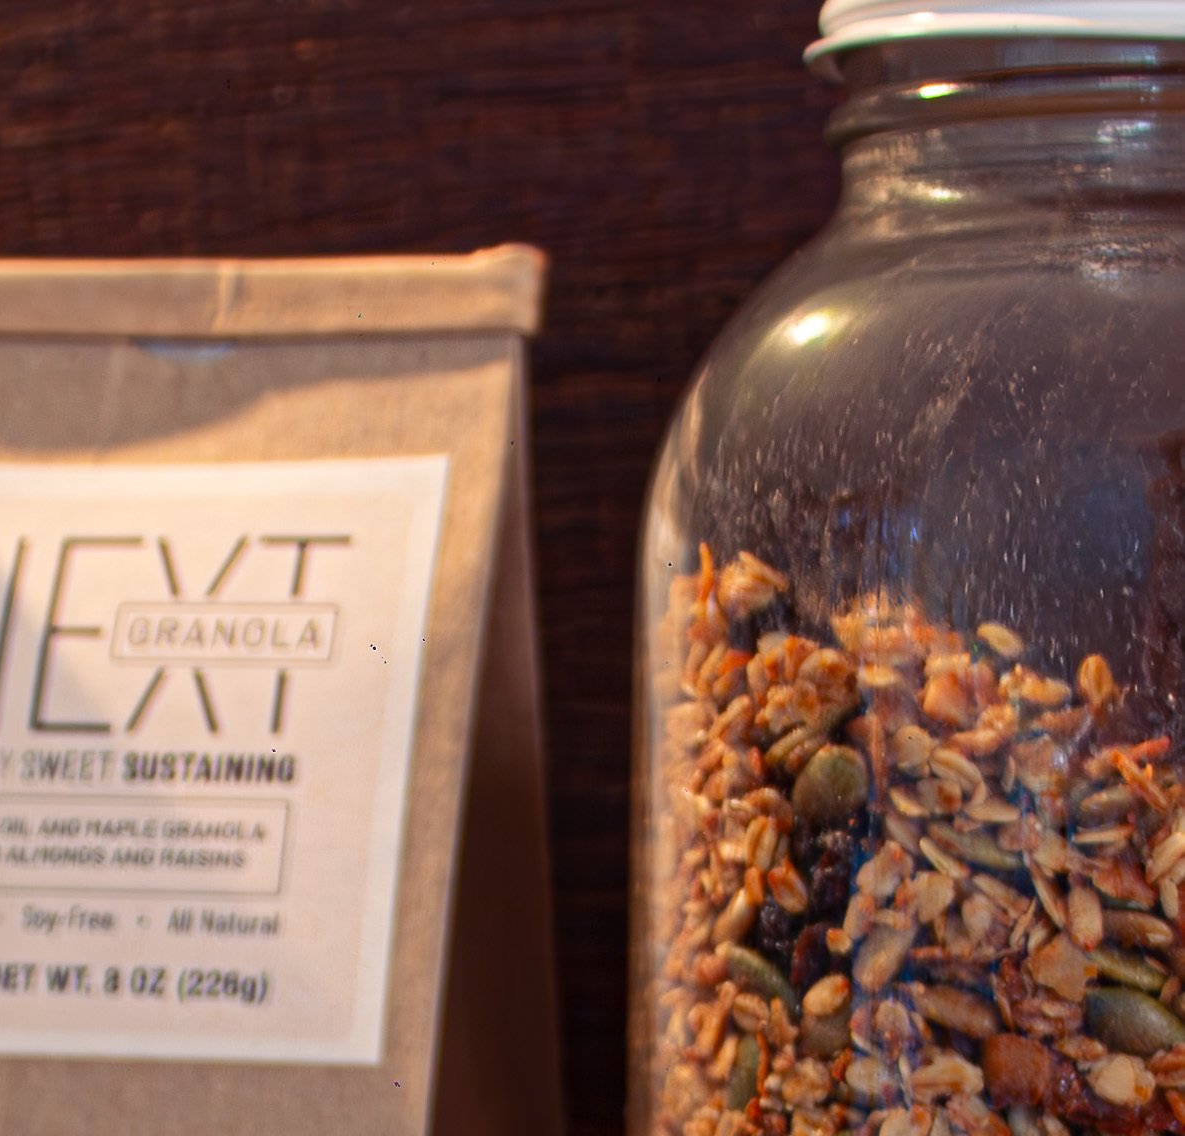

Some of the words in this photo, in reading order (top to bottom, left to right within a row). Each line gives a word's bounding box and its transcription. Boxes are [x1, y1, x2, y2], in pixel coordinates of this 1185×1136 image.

[127, 616, 322, 652] GRANOLA
[20, 751, 114, 783] SWEET
[122, 752, 296, 784] SUSTAINING
[0, 817, 28, 839] OIL
[36, 818, 80, 840] AND
[85, 818, 158, 841] MAPLE
[161, 820, 267, 843] GRANOLA
[5, 845, 105, 867] ALMONDS
[111, 847, 155, 868] AND
[160, 848, 246, 869] RAISINS
[21, 905, 116, 934] Soy-Free
[167, 908, 193, 934] All
[199, 909, 281, 935] Natural
[46, 964, 94, 993] WT.
[103, 966, 120, 993] 8
[130, 966, 167, 995] OZ
[176, 968, 270, 1003] (226g)
